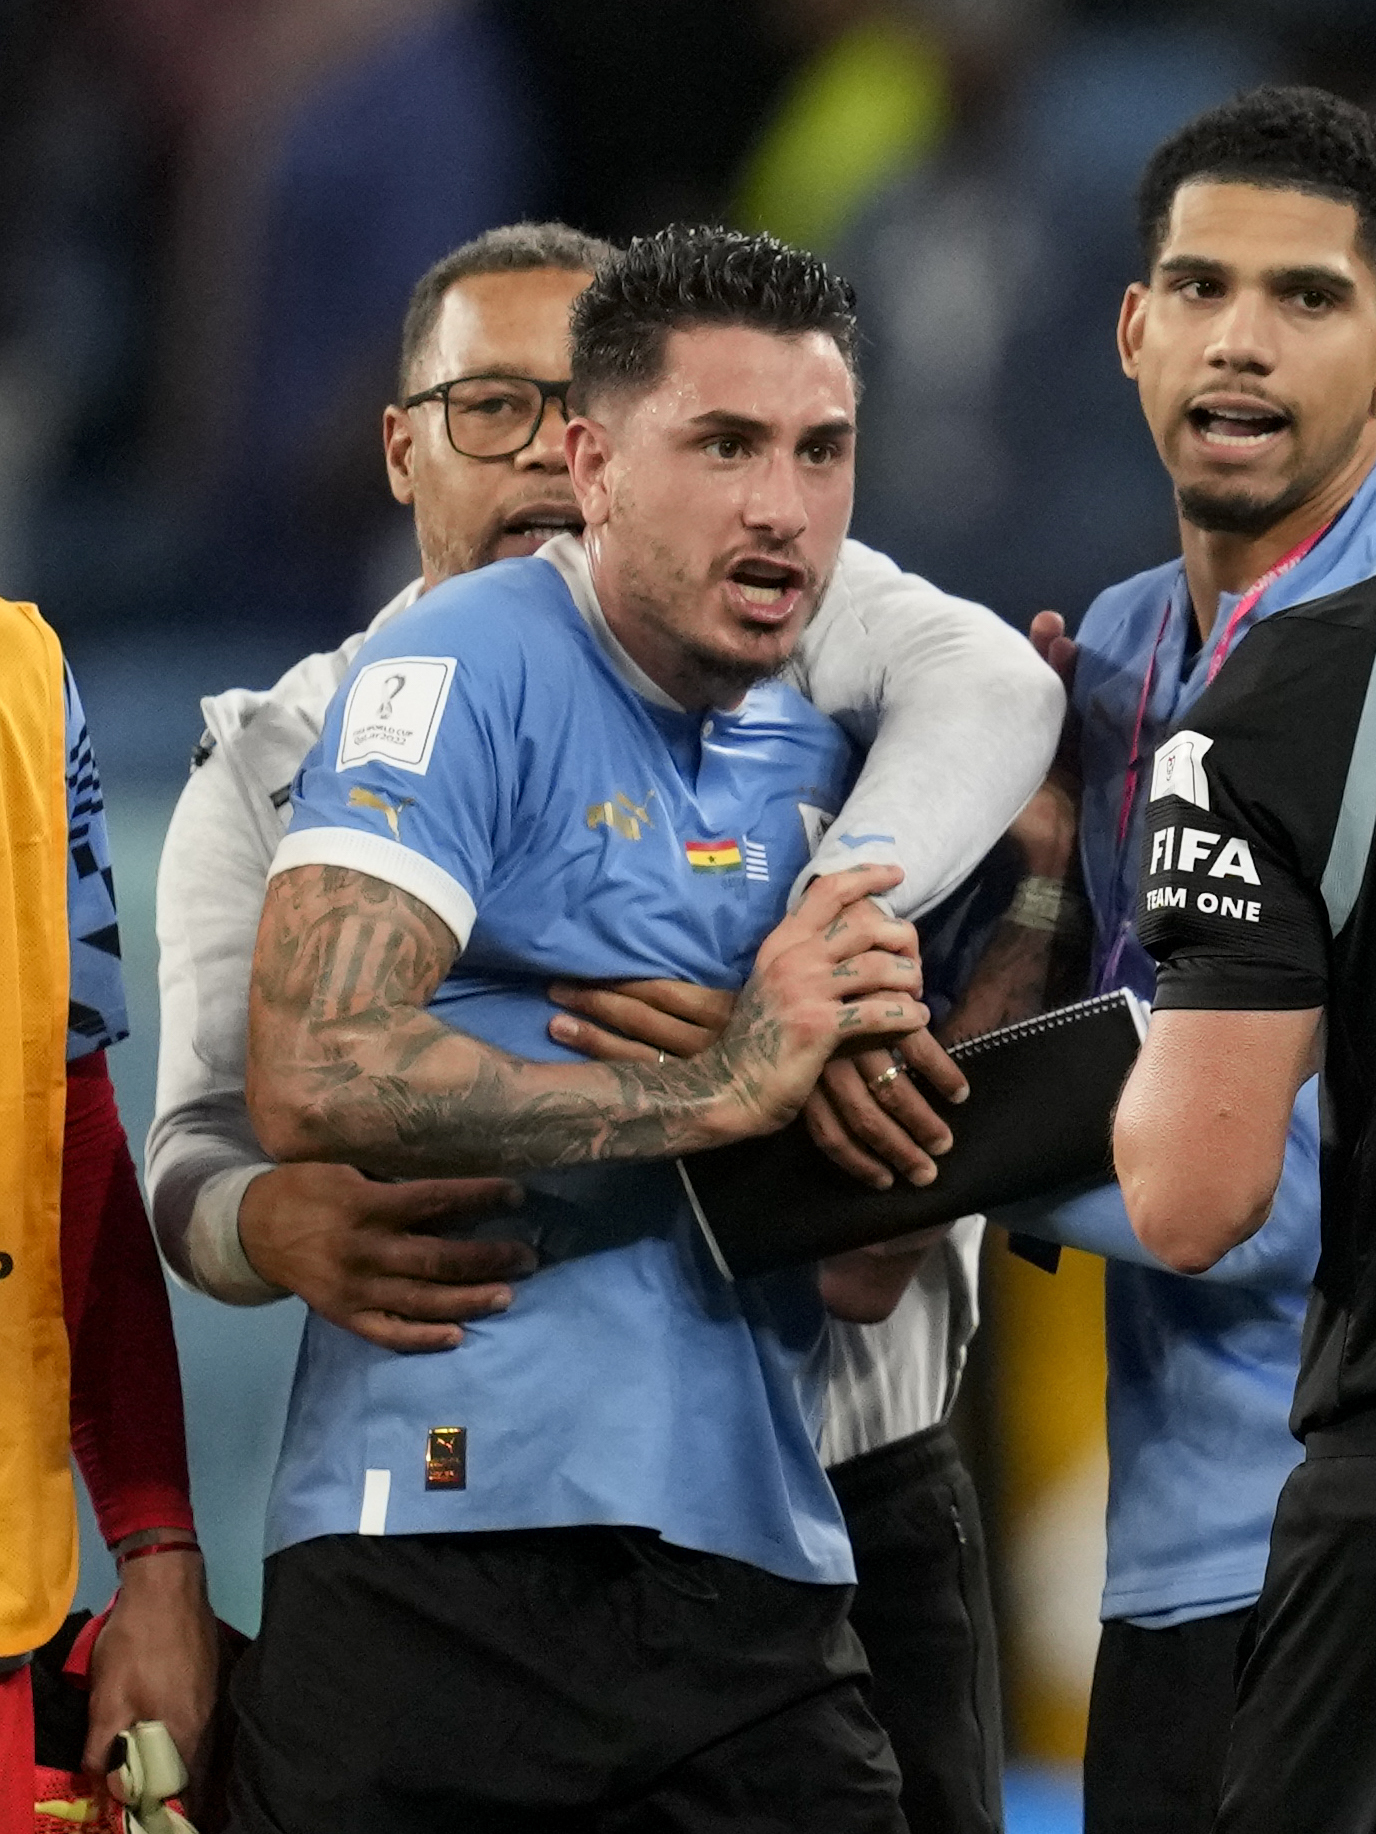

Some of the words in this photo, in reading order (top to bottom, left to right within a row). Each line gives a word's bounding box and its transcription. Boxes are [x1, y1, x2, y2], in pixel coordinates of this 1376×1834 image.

[1149, 826, 1262, 886] FIFA
[1146, 886, 1187, 912] TEAM
[1197, 892, 1262, 923] ONE
